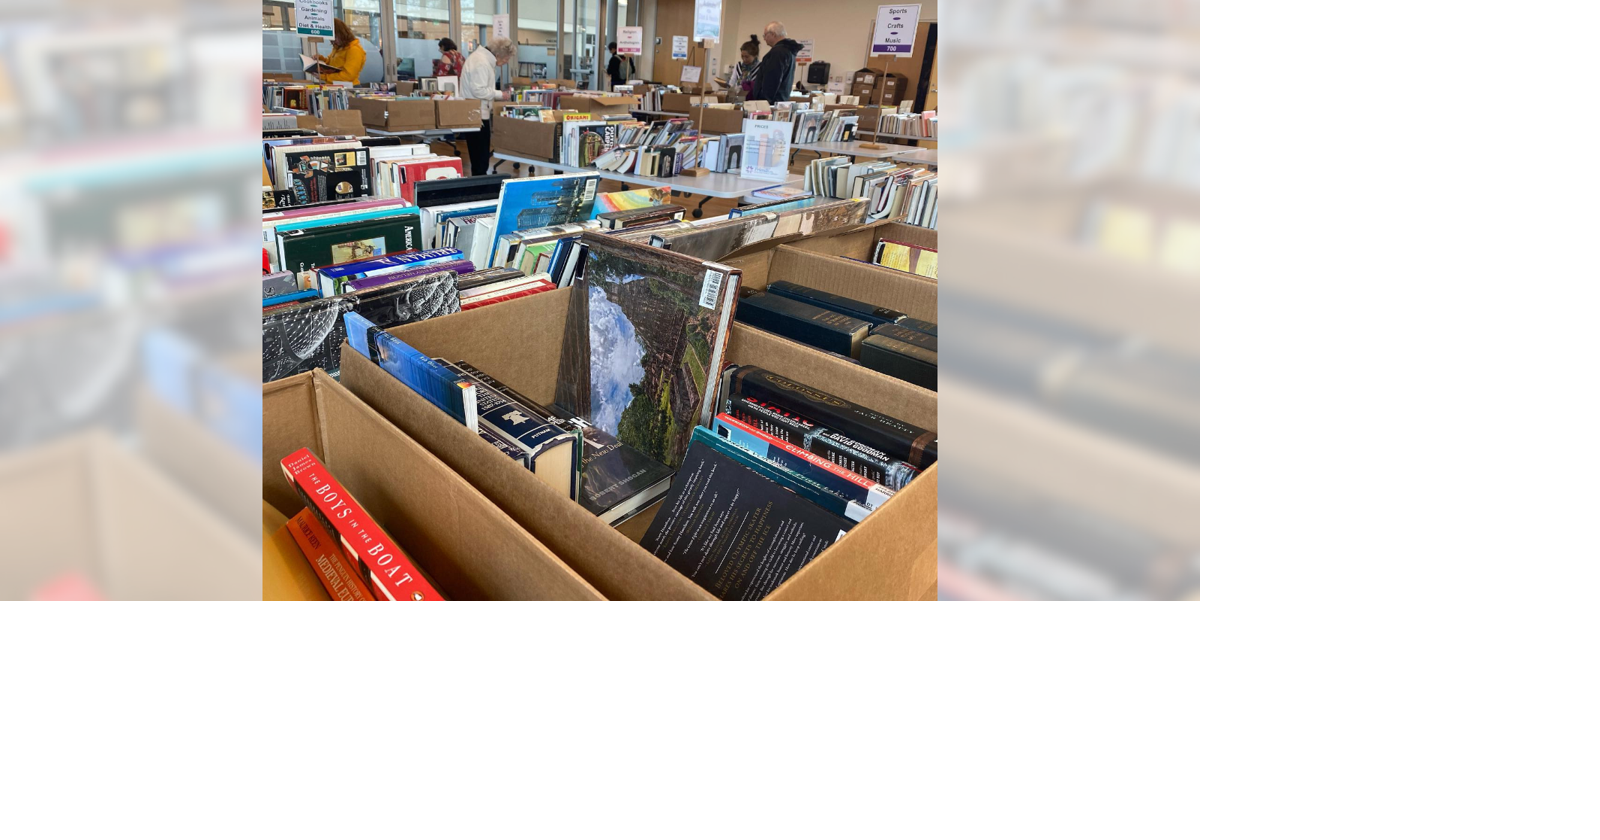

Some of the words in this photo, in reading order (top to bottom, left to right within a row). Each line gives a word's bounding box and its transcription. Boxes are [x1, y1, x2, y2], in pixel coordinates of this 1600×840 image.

[531, 428, 550, 439] PUTNAM
[829, 434, 853, 446] DAVID
[851, 444, 890, 461] GOODMAN
[288, 454, 310, 468] Daniel
[292, 459, 312, 471] James
[582, 452, 592, 466] the
[593, 444, 609, 458] New
[610, 440, 624, 452] Deal
[724, 415, 749, 429] HARRISON
[785, 444, 832, 469] CLIMBING
[833, 466, 845, 475] THE
[846, 473, 870, 487] HILL
[294, 462, 316, 475] Brown
[588, 482, 618, 501] ROBERT
[618, 468, 646, 488] SHOGAN
[296, 516, 312, 538] MAURICE
[307, 534, 322, 550] KEEN
[309, 473, 320, 484] THE
[316, 484, 352, 518] BOYS
[348, 519, 359, 528] IN
[358, 529, 372, 543] THE
[368, 542, 413, 587] BOAT
[708, 533, 719, 548] through
[728, 568, 738, 581] HIS
[735, 543, 752, 569] SECRETS
[748, 534, 757, 543] TO
[753, 499, 773, 534] HAPPINESS
[714, 558, 734, 589] BELOVED
[730, 529, 750, 560] OLYMPIC
[746, 506, 763, 530] SKATER
[733, 577, 743, 589] ON
[739, 562, 751, 578] AND
[747, 549, 758, 563] OFF
[754, 536, 765, 549] THE
[762, 523, 771, 535] ICE
[315, 554, 344, 592] MEDIEVAL
[328, 552, 338, 564] THE
[333, 561, 350, 582] PENGUIN
[345, 578, 362, 599] HISTORY
